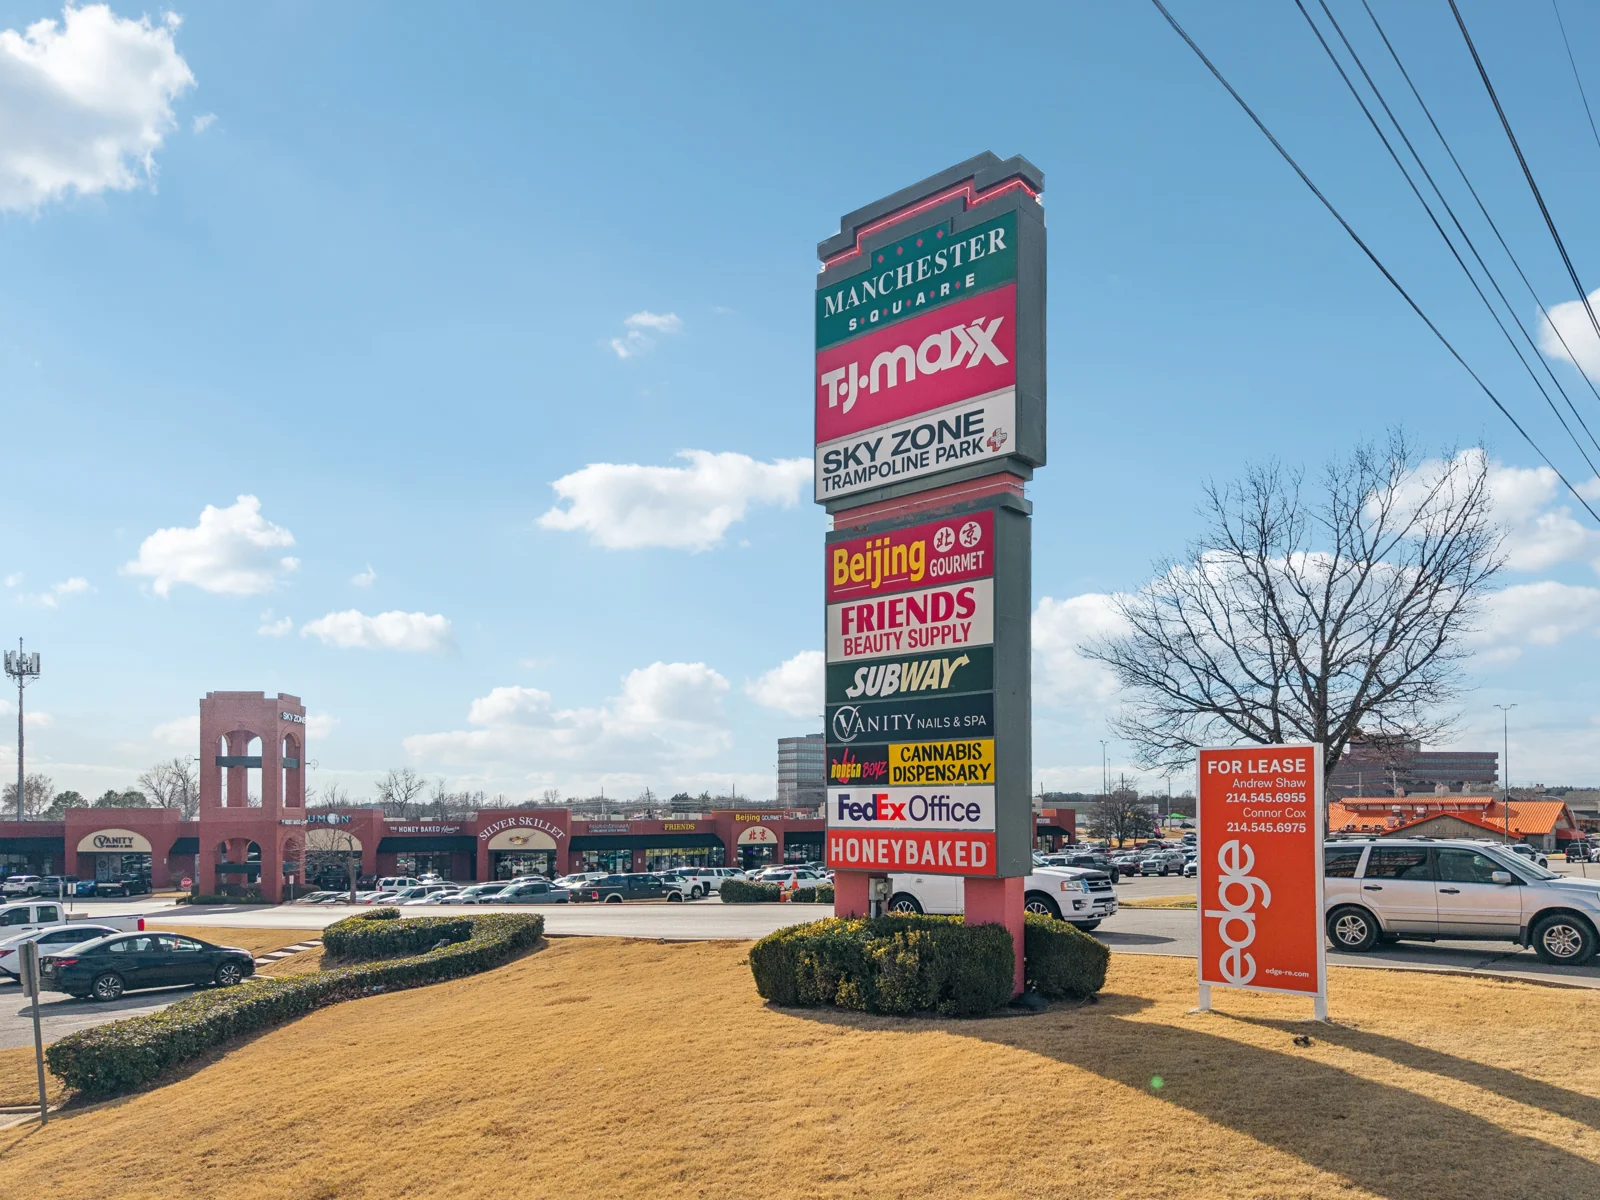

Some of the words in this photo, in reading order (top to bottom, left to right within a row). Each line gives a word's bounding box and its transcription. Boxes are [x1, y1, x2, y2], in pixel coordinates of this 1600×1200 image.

[824, 227, 1007, 318] MANCHESTER
[823, 437, 883, 474] SKY
[891, 408, 985, 456] ZONE
[823, 451, 929, 492] TRAMPOLINE
[936, 436, 985, 464] PARK
[833, 537, 926, 588] Beijing
[930, 550, 985, 577] GOURMET
[841, 587, 976, 636] FRIENDS
[844, 631, 902, 656] BEAUTY
[908, 622, 972, 649] SUPPLY
[845, 653, 970, 699] SUBWAY
[283, 711, 293, 721] SKY
[833, 705, 915, 742] VANITY
[917, 716, 950, 729] NAILS
[953, 717, 961, 728] &
[964, 714, 987, 727] SPA
[901, 743, 982, 763] CANNABIS
[831, 763, 861, 779] BODEGA
[893, 763, 991, 783] DISPENSARY
[1208, 760, 1242, 774] FOR
[1248, 758, 1306, 774] LEASE
[1232, 778, 1273, 788] Andrew
[1275, 777, 1306, 788] Shaw
[838, 793, 906, 821] FedEx
[908, 795, 981, 822] Office
[1226, 792, 1306, 803] 214.545.6955
[735, 814, 760, 823] Beijing
[1243, 807, 1282, 818] Connor
[1285, 807, 1306, 818] Cox
[479, 817, 516, 841] SILVER
[519, 816, 566, 840] SKILLET
[1226, 822, 1306, 833] 214.545.6975
[93, 834, 133, 848] VANITY
[831, 838, 987, 868] HONEYBAKED
[1204, 839, 1271, 985] edge
[1265, 968, 1310, 978] edge-re.com
